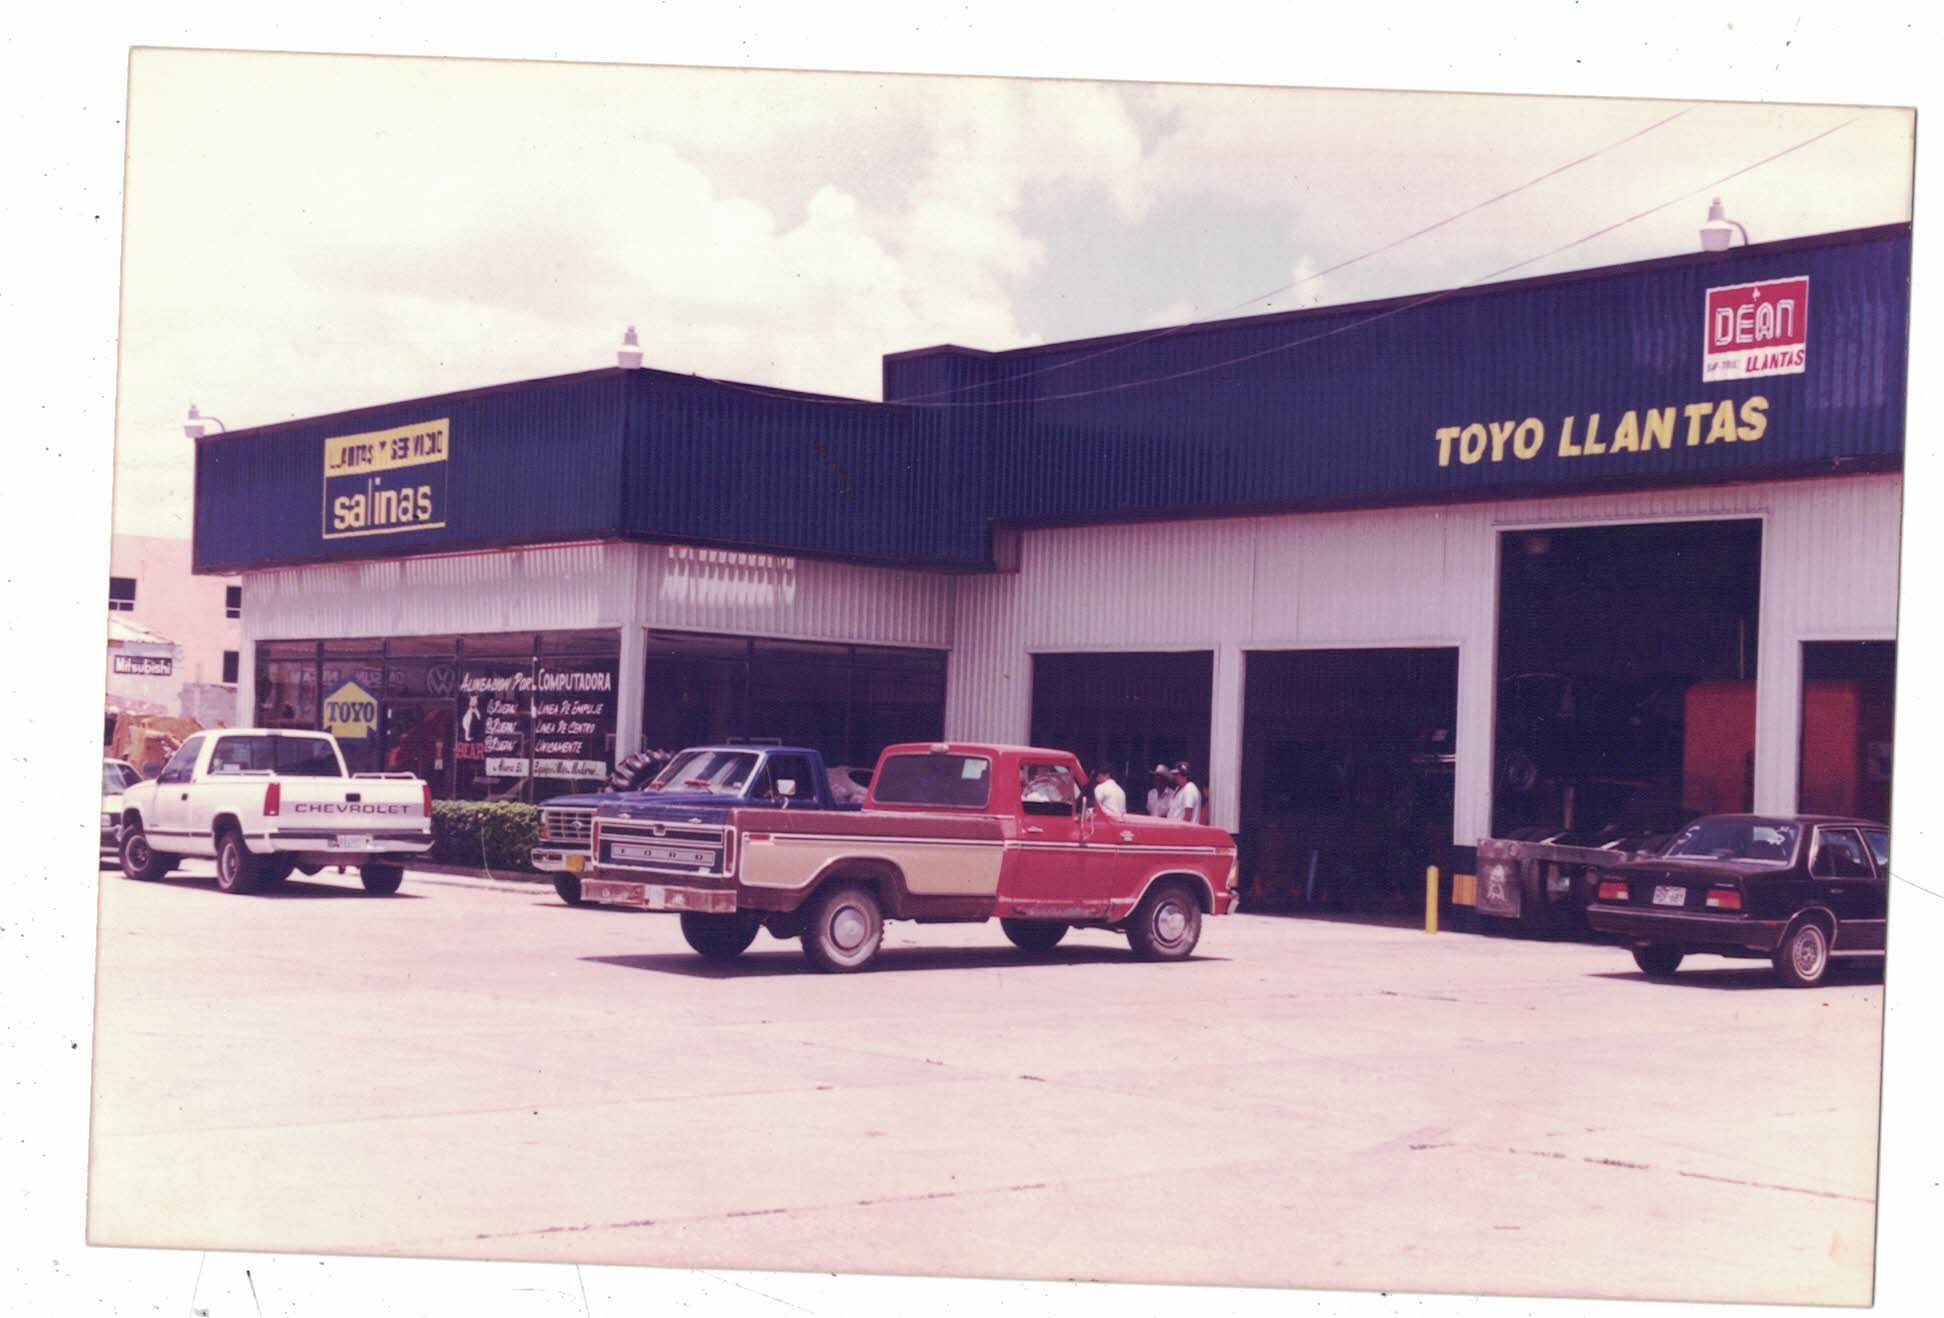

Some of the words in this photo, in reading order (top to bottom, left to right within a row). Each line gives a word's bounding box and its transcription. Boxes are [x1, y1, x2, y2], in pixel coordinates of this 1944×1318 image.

[1714, 299, 1795, 346] DEAN
[1745, 349, 1805, 373] LLANTAS
[1435, 417, 1545, 467] TOYO
[1558, 396, 1770, 457] LLANTAS
[333, 477, 432, 529] salinas
[538, 668, 612, 691] COMPUTADORA
[327, 702, 375, 722] TOYO
[295, 803, 410, 814] CHEVROLET
